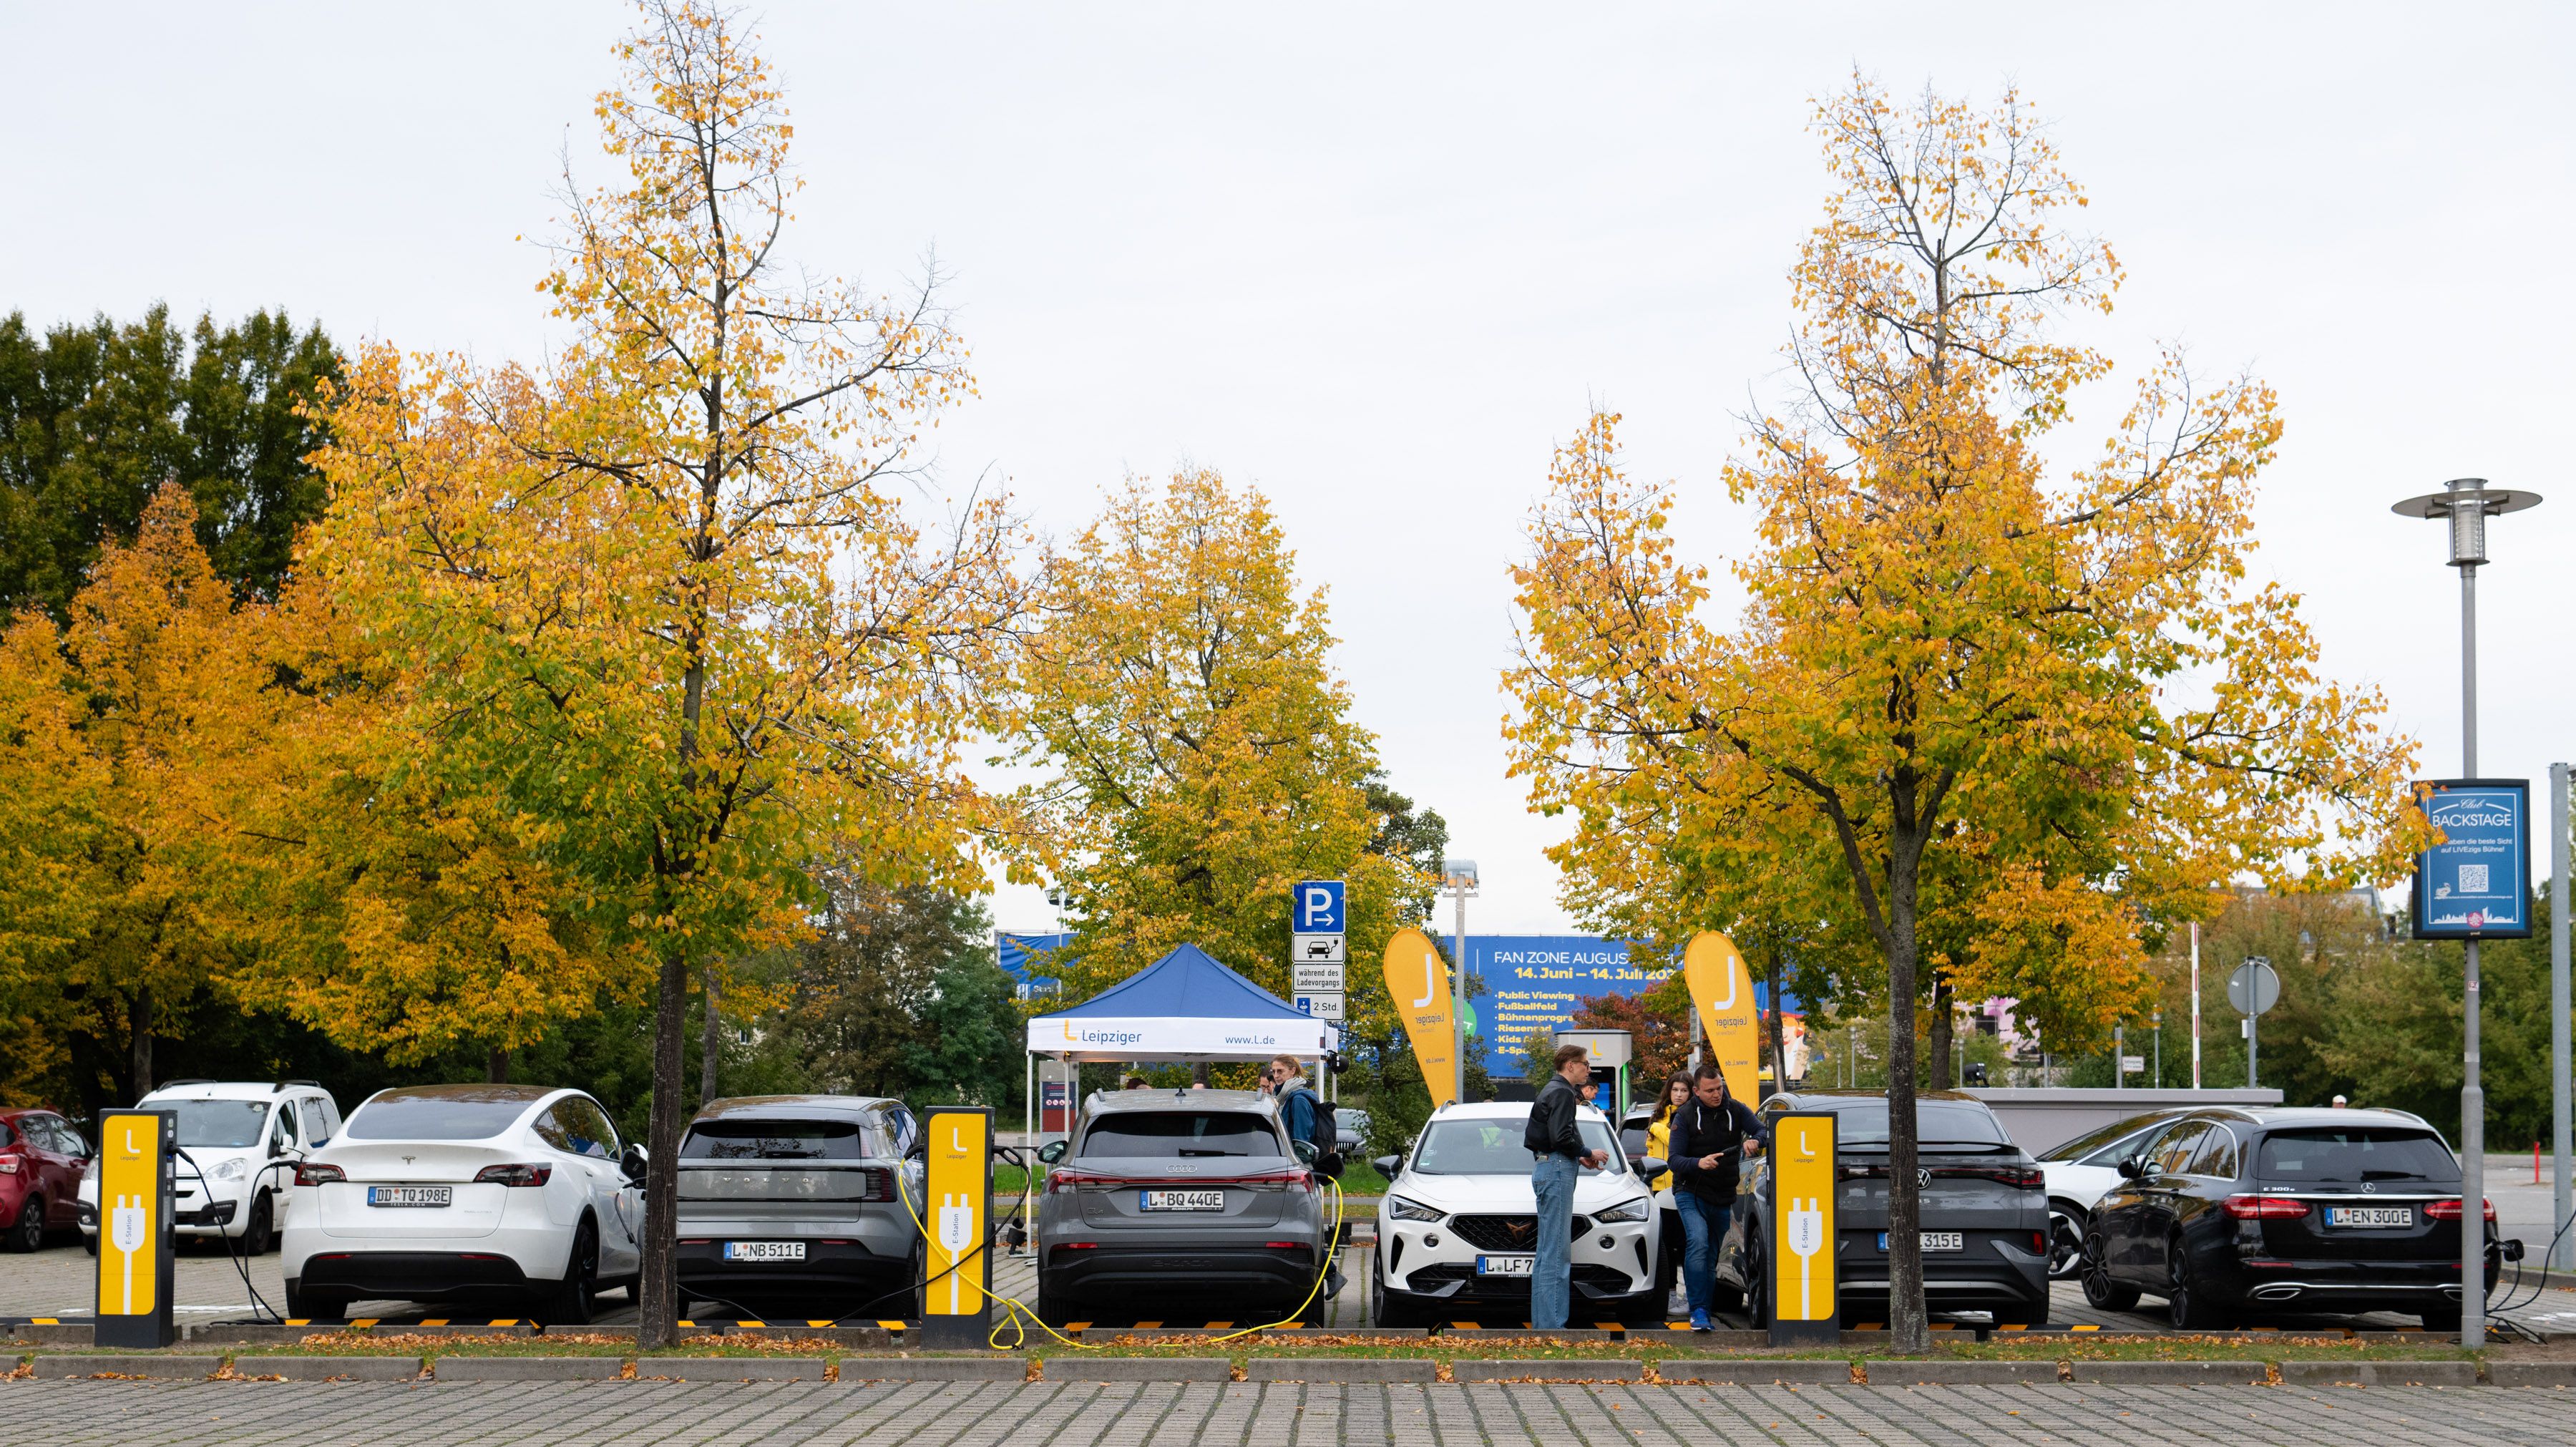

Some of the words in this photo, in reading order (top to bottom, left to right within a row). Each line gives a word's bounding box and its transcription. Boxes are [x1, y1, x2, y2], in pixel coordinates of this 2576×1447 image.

[2461, 799, 2487, 809] Club
[2433, 814, 2512, 827] BACKSTAGE
[1306, 888, 1332, 926] P
[1495, 952, 1523, 963] FAN
[1527, 952, 1570, 964] ZONE
[1573, 953, 1630, 965] AUGUS
[1514, 968, 1538, 979] 14.
[1540, 968, 1573, 979] Juni
[1590, 968, 1613, 980] 14.
[1615, 968, 1643, 980] Juli
[1646, 969, 1676, 980] 202
[1297, 979, 1340, 988] Ladevorgangs
[1531, 991, 1574, 1001] Viewing
[1322, 1003, 1340, 1011] Std.
[1498, 1002, 1557, 1010] Fußballfeld
[1498, 1013, 1574, 1023] Bühnenprogra
[1082, 1029, 1142, 1045] Leipziger
[1225, 1035, 1275, 1045] www.L.de
[376, 1189, 391, 1202] DD
[401, 1189, 416, 1202] TQ
[419, 1189, 449, 1202] 198E
[1149, 1194, 1157, 1206] L
[1167, 1194, 1184, 1206] BQ
[1188, 1194, 1221, 1206] 440E
[2334, 1210, 2343, 1223] L
[2352, 1210, 2370, 1223] EN
[2374, 1210, 2411, 1223] 300E
[733, 1244, 741, 1257] L
[749, 1244, 766, 1257] NB
[1486, 1260, 1494, 1272] L
[1505, 1260, 1522, 1272] LF
[1525, 1260, 1533, 1272] 7
